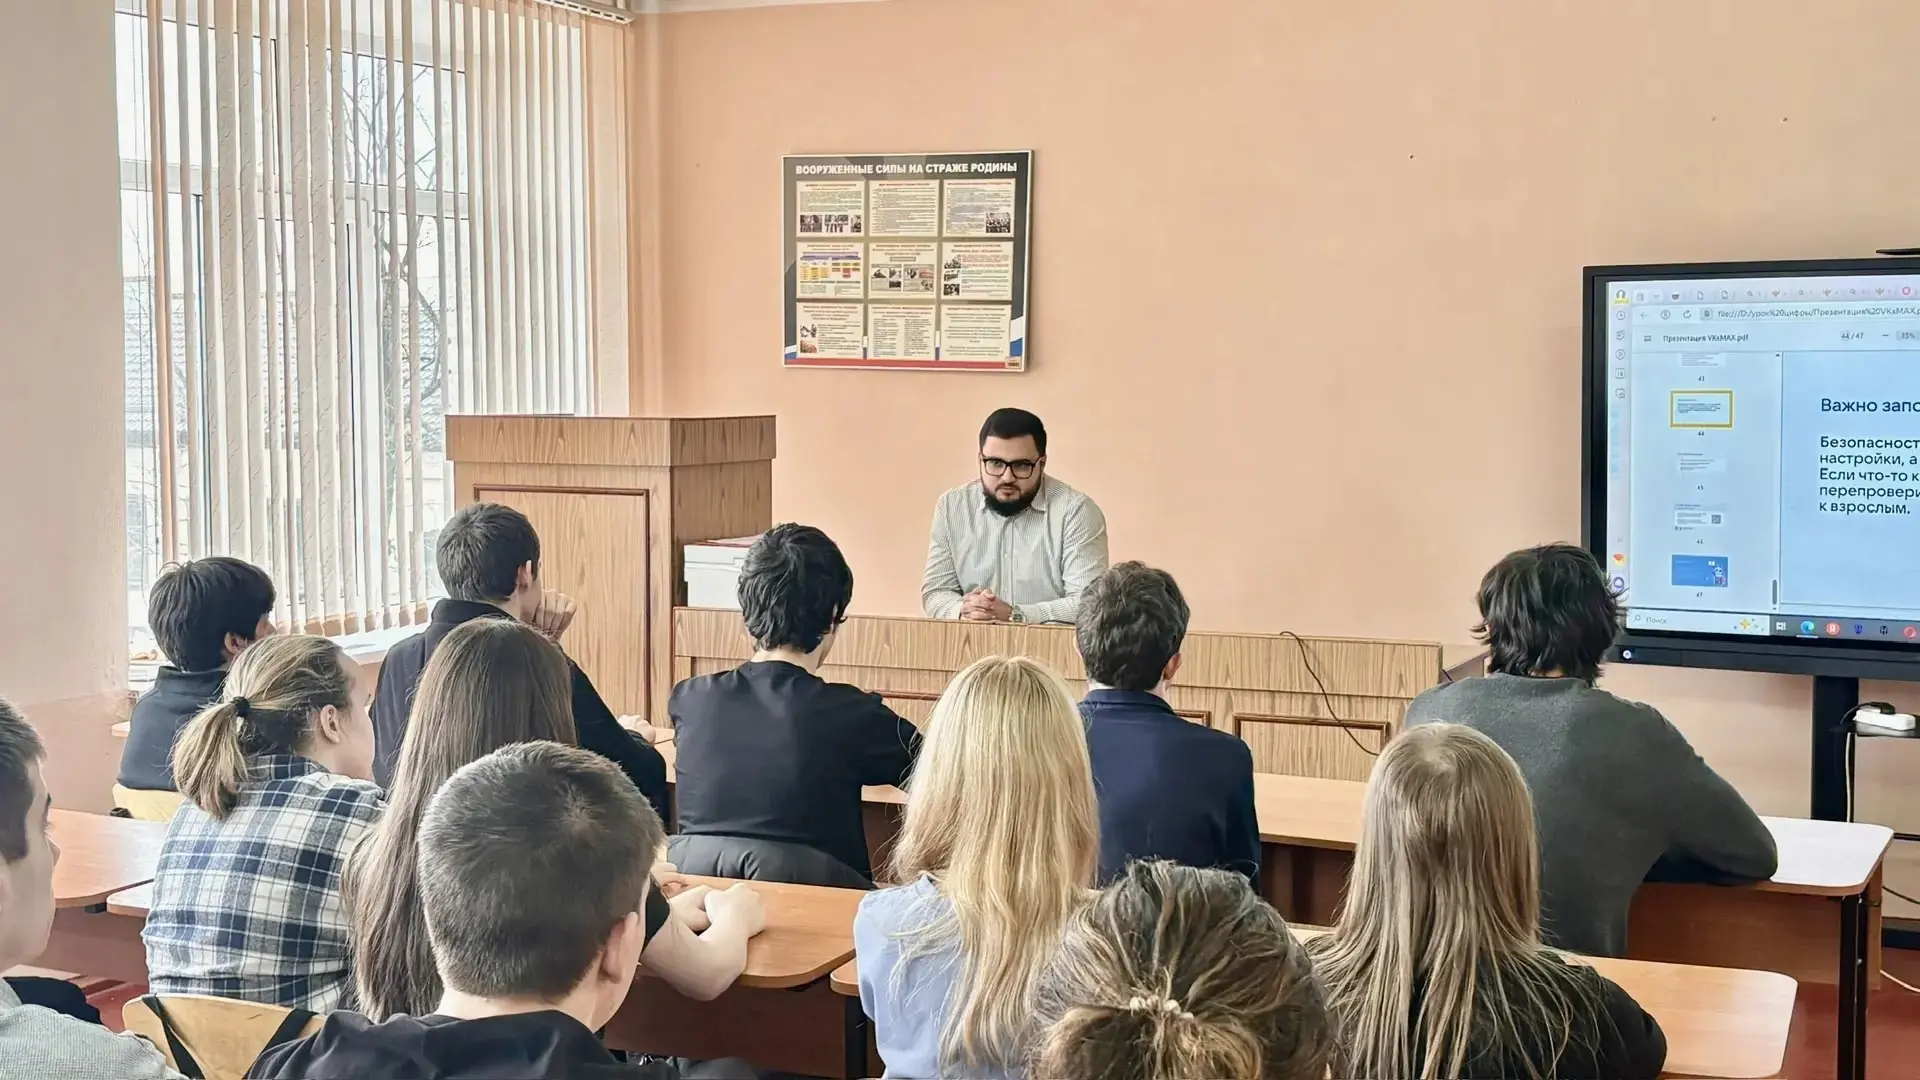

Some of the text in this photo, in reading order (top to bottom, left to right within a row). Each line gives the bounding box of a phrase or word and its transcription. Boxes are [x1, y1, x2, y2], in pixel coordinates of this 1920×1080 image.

[795, 162, 1017, 174] ВООРУЖЕННЫЕ СИЛЫ НА СТРАЖЕ РОДИНЫ
[1821, 398, 1878, 412] Важно
[1820, 436, 1920, 449] Безопасност
[1820, 452, 1918, 467] настройки, а
[1820, 467, 1920, 481] Если что-то к
[1820, 502, 1911, 515] к взрослым.
